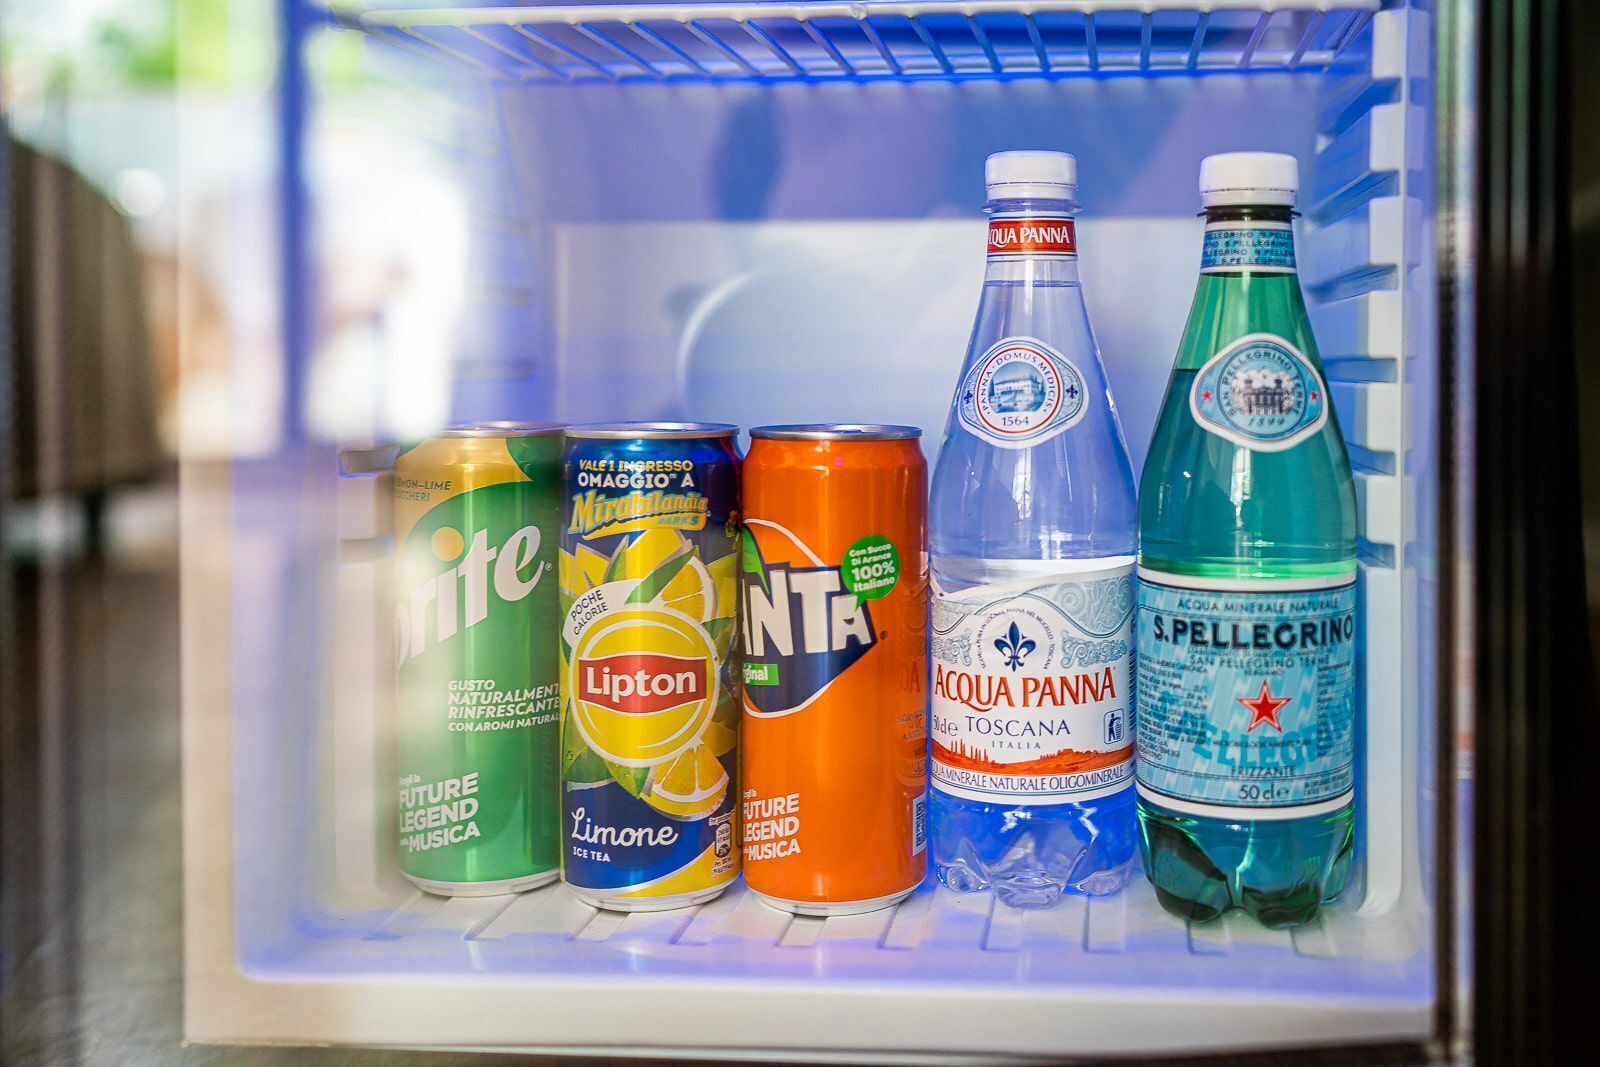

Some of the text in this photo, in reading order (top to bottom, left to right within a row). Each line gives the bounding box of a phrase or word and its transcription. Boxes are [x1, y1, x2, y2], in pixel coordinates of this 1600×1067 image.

[988, 226, 1070, 248] CQUA PANNA
[981, 352, 1056, 412] PANNA DOMUS MEDICIS
[1001, 416, 1029, 427] 1564
[579, 460, 607, 471] VALE
[617, 460, 693, 472] INGRESSO
[681, 473, 695, 487] A
[568, 489, 708, 534] Mirabilandia
[852, 560, 895, 581] 100%
[854, 577, 895, 592] Italiano
[571, 590, 604, 621] POCHE
[1177, 597, 1339, 613] ACQUA MINERALE NATURALE
[573, 602, 608, 635] CALORIE
[1154, 615, 1353, 650] S.PELLEGRINO
[1219, 657, 1295, 669] PELLEGRINO
[448, 680, 495, 691] GUSTO
[448, 683, 560, 705] NATURALMENT
[586, 666, 696, 703] Lipton
[935, 664, 1116, 712] ACQUA PANNA
[448, 713, 560, 732] CON AROMI NATURAL
[965, 716, 1071, 737] TOSCANA
[991, 741, 1041, 750] ITALIA
[945, 769, 991, 787] MINERALE
[990, 777, 1047, 791] NATURALE
[1049, 766, 1124, 790] OLIGOMINERALE
[1231, 765, 1294, 777] FRIZZANTE
[400, 772, 478, 809] FUTURE
[1239, 784, 1259, 799] 50
[1262, 783, 1274, 799] cl
[400, 797, 479, 833] LEGEND
[409, 821, 481, 853] MUSICA
[571, 807, 678, 847] Limone
[573, 846, 610, 862] ICE TEA
[748, 838, 801, 861] MUSICA
